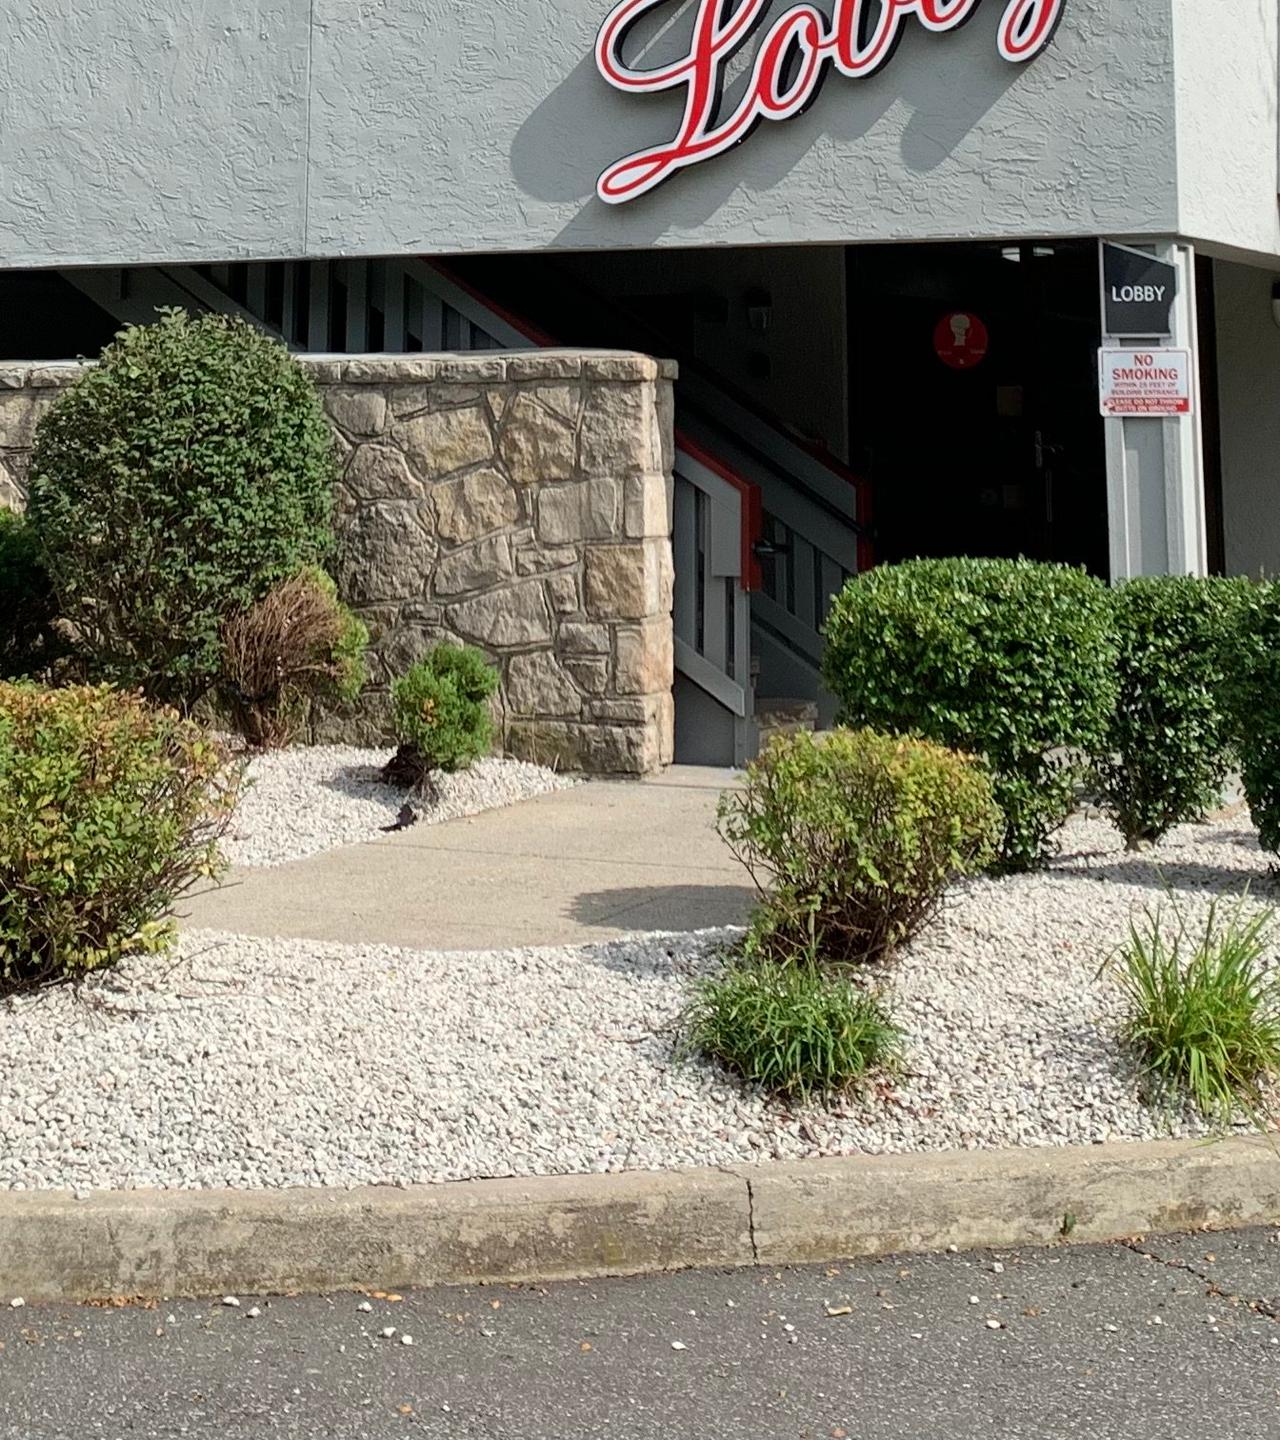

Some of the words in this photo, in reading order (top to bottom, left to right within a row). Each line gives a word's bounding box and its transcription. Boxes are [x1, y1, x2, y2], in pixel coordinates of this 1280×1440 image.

[1111, 285, 1166, 303] LOBBY
[1133, 354, 1154, 367] NO
[1112, 368, 1179, 381] SMOKING
